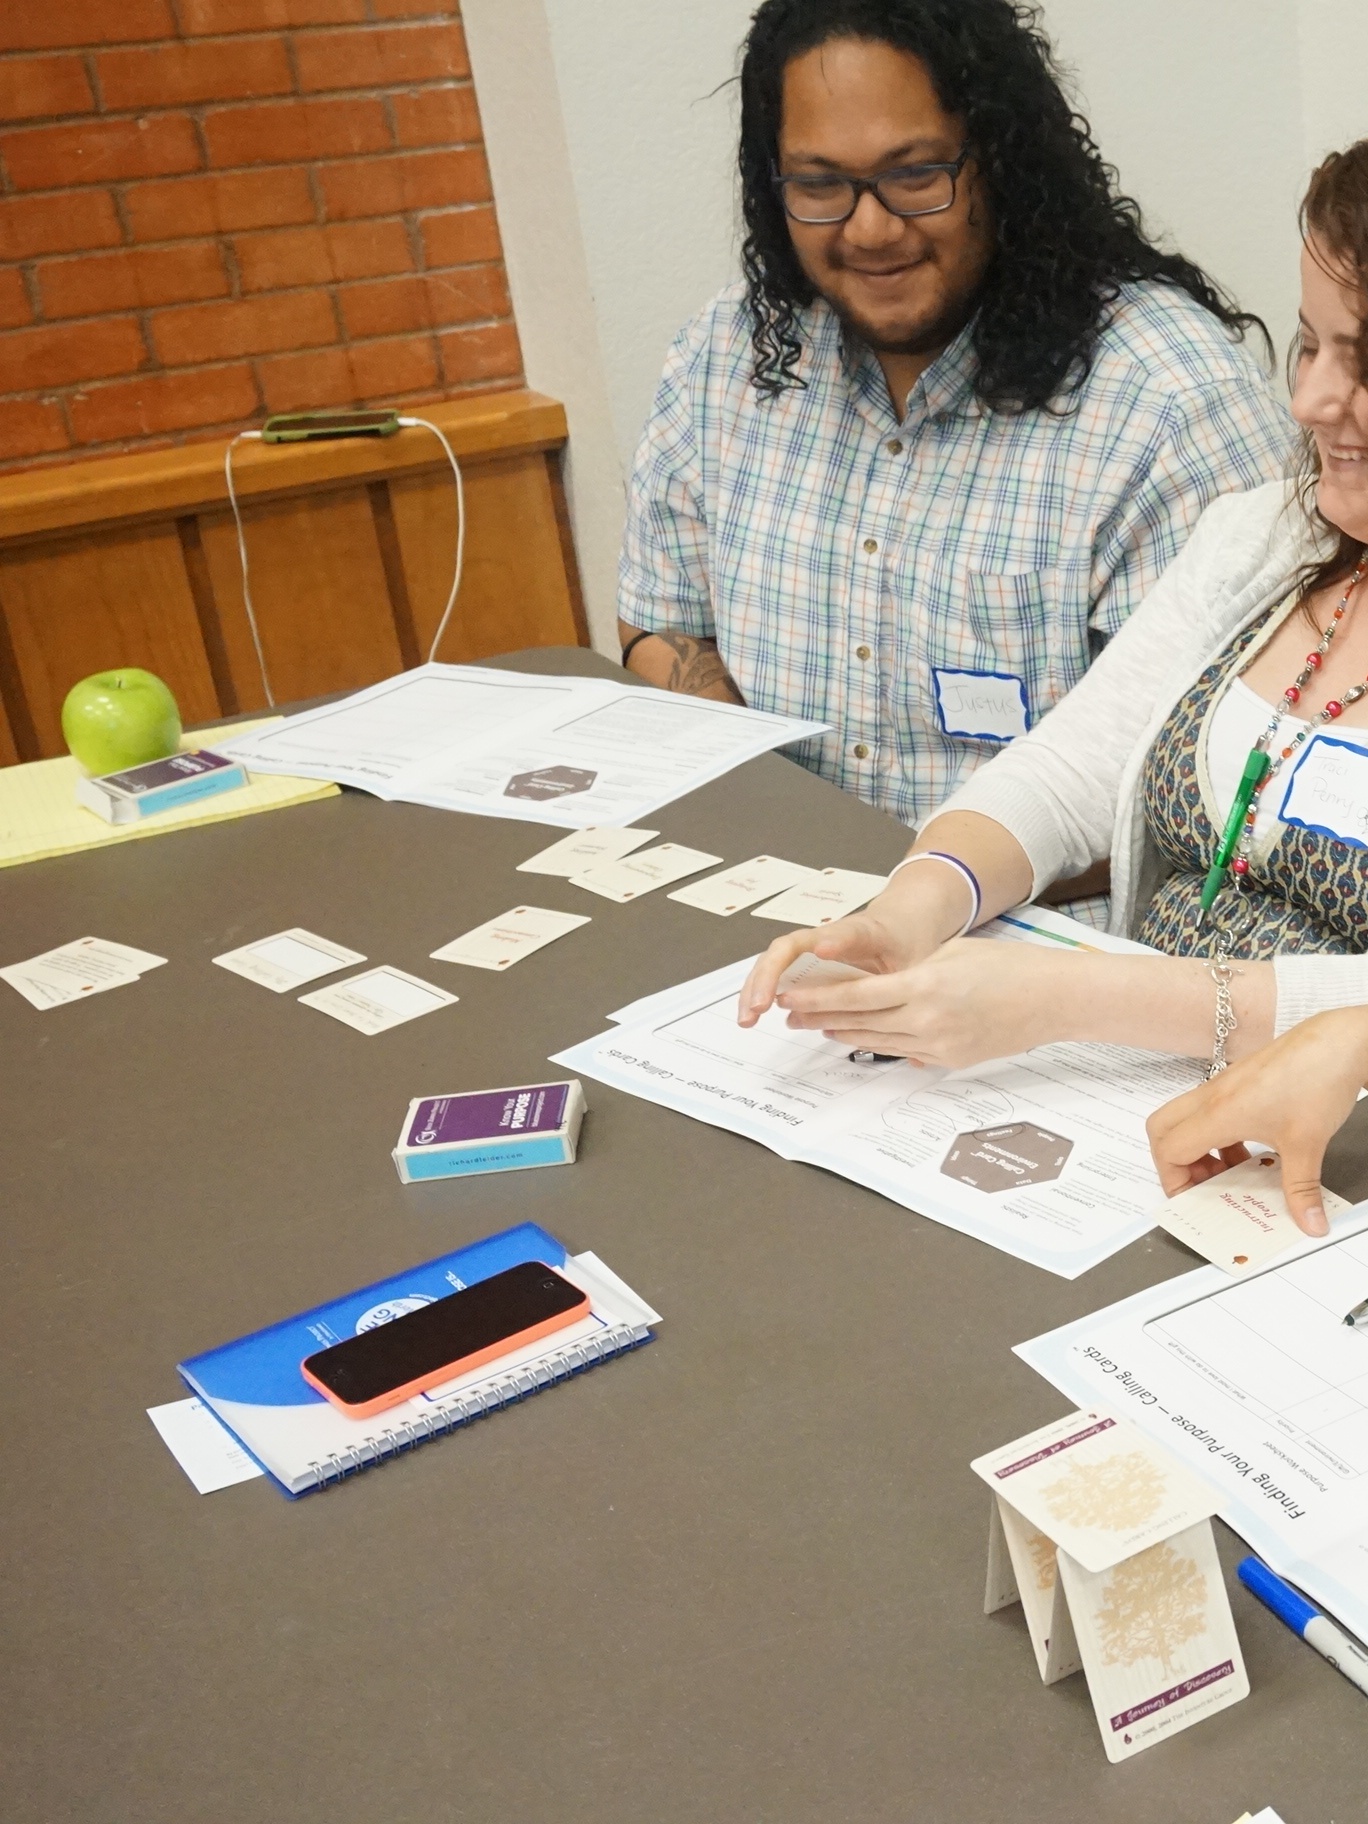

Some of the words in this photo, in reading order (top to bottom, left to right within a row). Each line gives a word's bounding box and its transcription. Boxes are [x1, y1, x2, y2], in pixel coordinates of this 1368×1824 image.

[636, 1060, 674, 1079] Calling
[687, 1080, 733, 1099] Purpose
[731, 1096, 758, 1108] Your
[503, 1098, 515, 1110] Your
[511, 1093, 531, 1129] PURPOSE
[759, 1104, 803, 1126] Finding
[499, 1109, 511, 1127] Know
[982, 1143, 1038, 1169] Environments
[996, 1159, 1024, 1174] Calling
[1219, 1192, 1274, 1233] Instructing
[1243, 1193, 1277, 1218] People
[1115, 1371, 1158, 1405] Calling
[1061, 1422, 1101, 1448] Journey
[1171, 1415, 1224, 1453] Purpose
[1049, 1443, 1061, 1453] of
[1262, 1441, 1299, 1469] Worksheet
[997, 1448, 1047, 1480] Discovery
[1221, 1452, 1253, 1477] Your
[1298, 1468, 1328, 1492] Purpose
[1252, 1473, 1305, 1519] Finding
[1111, 1715, 1124, 1728] A
[1124, 1697, 1168, 1722] Journey
[1167, 1687, 1182, 1700] of
[1181, 1664, 1233, 1692] Discovery
